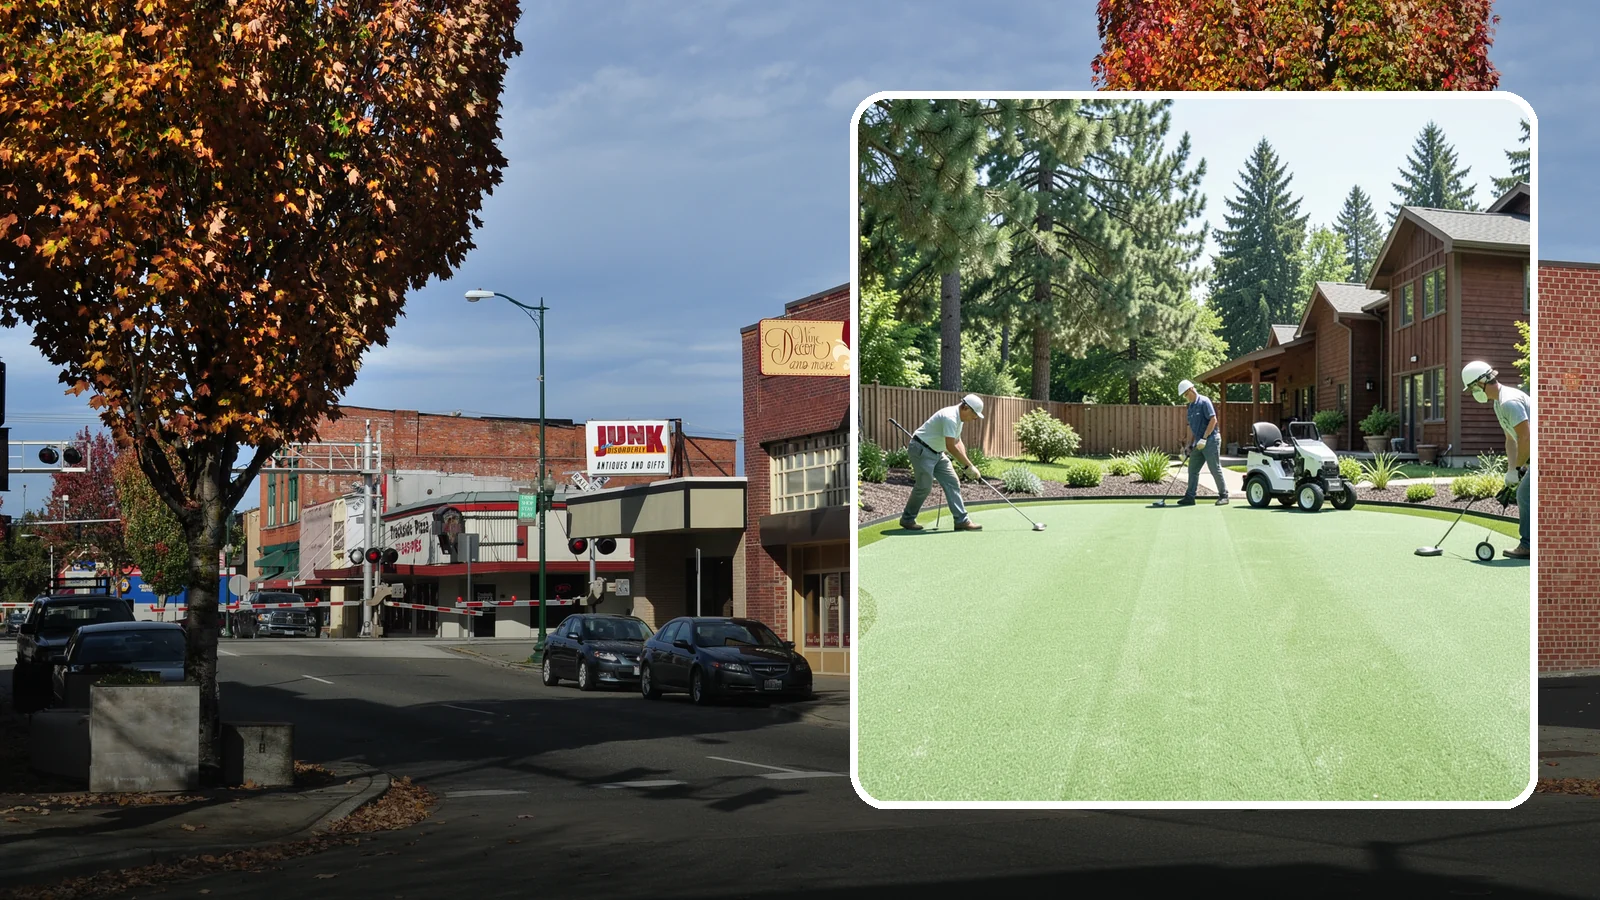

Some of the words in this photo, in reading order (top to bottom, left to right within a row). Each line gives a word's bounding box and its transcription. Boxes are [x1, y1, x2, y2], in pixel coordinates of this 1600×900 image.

[595, 425, 665, 457] JUNK
[607, 446, 645, 454] DISORDERLY
[596, 461, 627, 470] ANTIQUES
[631, 461, 643, 469] AND
[647, 460, 665, 469] GIFTS
[390, 521, 412, 539] Trackside
[414, 519, 429, 535] Pizza
